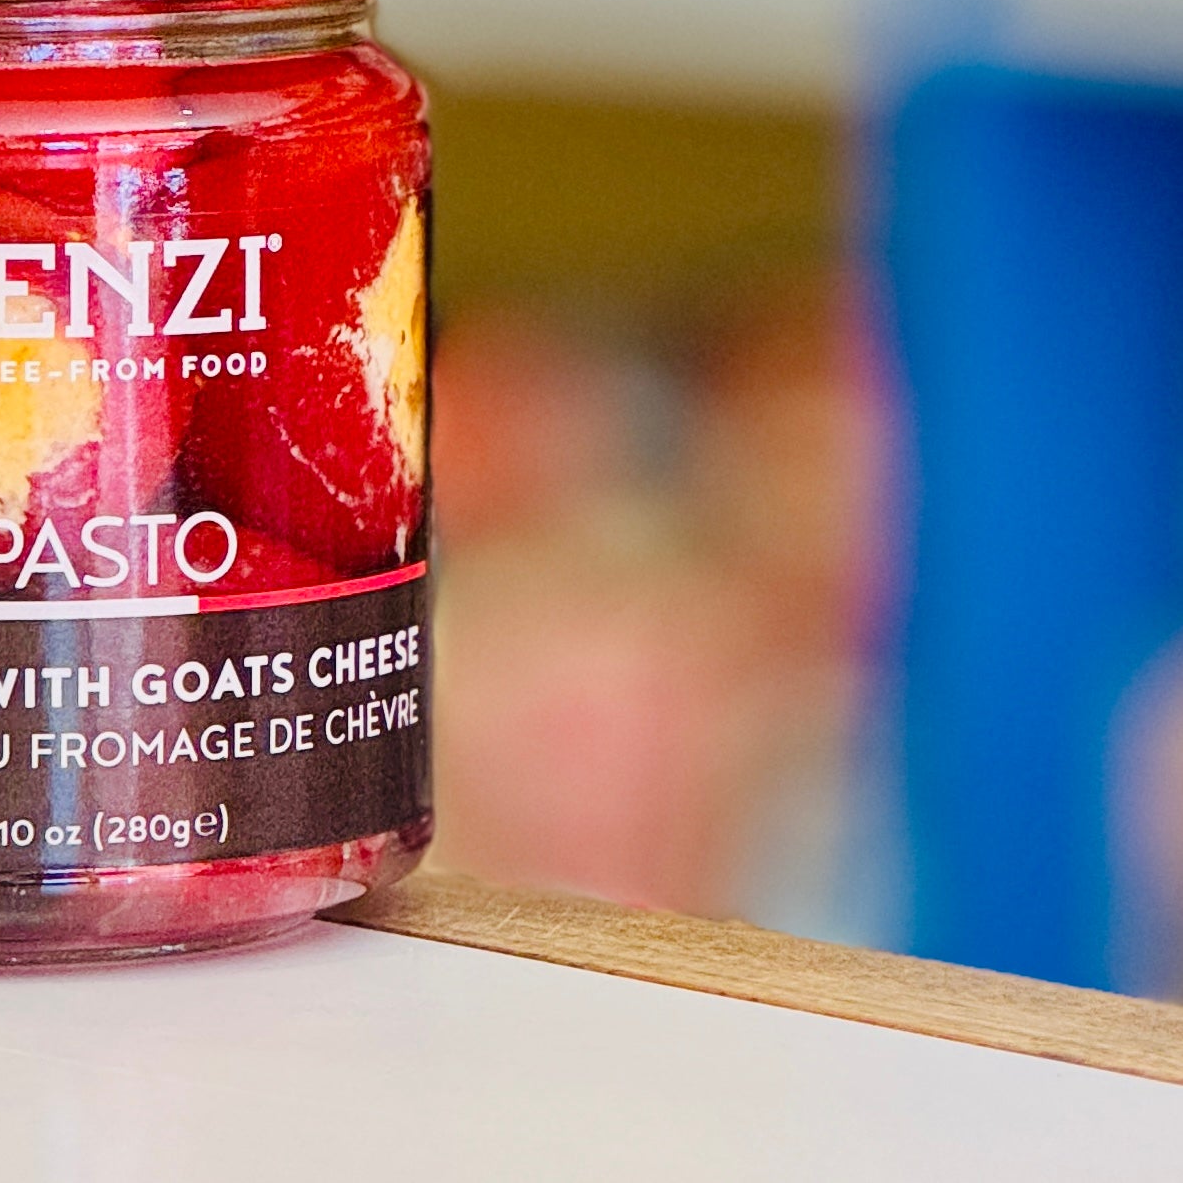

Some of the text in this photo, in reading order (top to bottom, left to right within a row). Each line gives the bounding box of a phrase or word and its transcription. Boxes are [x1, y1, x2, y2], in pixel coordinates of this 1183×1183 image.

[182, 351, 268, 379] FOOD
[131, 651, 294, 705] GOATS
[308, 624, 420, 689] CHEESE
[30, 721, 255, 769] FROMAGE
[269, 713, 314, 754] DE
[325, 687, 419, 746] CHÈVRE
[44, 823, 82, 847] oz
